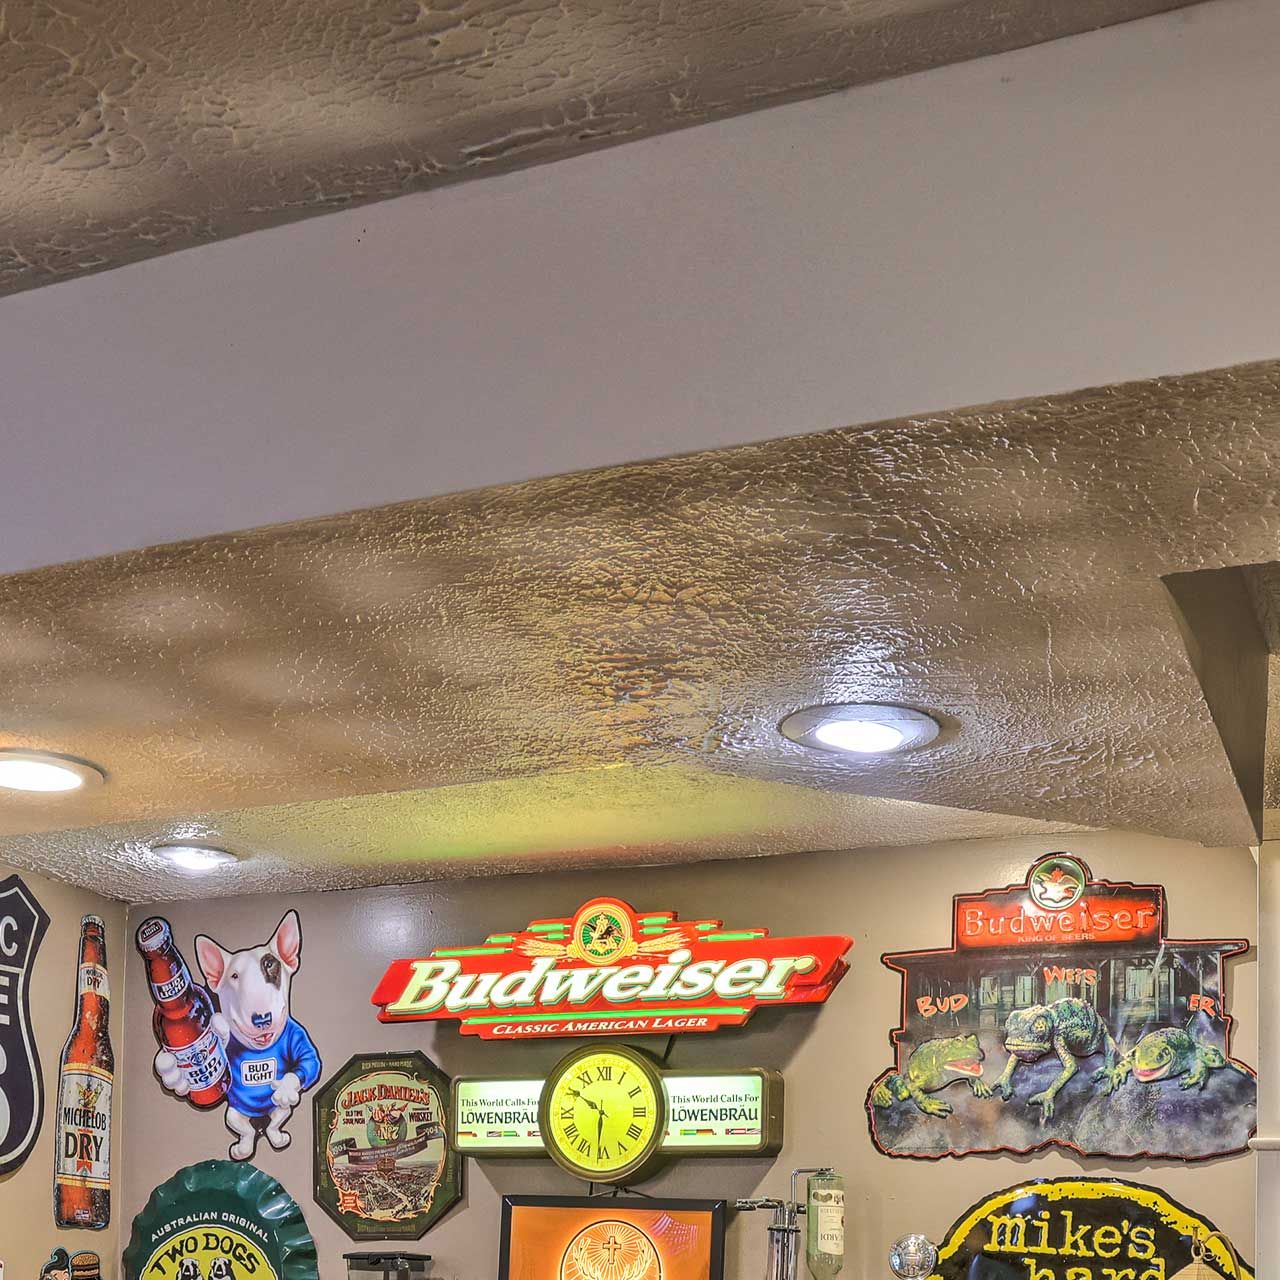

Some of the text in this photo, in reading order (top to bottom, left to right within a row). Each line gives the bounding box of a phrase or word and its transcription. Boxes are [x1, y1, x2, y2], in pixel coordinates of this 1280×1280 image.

[963, 900, 1155, 937] Budweiser
[1018, 934, 1044, 943] KING
[1062, 933, 1097, 942] BEERS
[160, 980, 186, 999] LIGHT
[162, 976, 181, 992] BUD
[389, 950, 819, 1014] Budweiser
[916, 994, 968, 1019] BUD
[1188, 993, 1215, 1017] ER
[492, 1017, 709, 1036] CLASSIC AMERICAN LAGER
[189, 1057, 217, 1078] BUD
[245, 1071, 273, 1082] LIGHT
[248, 1063, 269, 1073] BUD
[597, 1066, 612, 1081] XII
[576, 1070, 593, 1089] XI
[617, 1071, 627, 1085] I
[628, 1085, 642, 1099] II
[671, 1093, 760, 1104] This World Calls For
[461, 1098, 478, 1107] This
[479, 1098, 504, 1107] World
[505, 1098, 526, 1107] Calls
[633, 1107, 646, 1117] III
[63, 1106, 107, 1131] MICHELOB
[561, 1106, 574, 1119] IX
[563, 1122, 580, 1145] VIII
[626, 1122, 643, 1141] IIII
[64, 1131, 104, 1162] DRY
[577, 1139, 591, 1157] VII
[617, 1141, 628, 1155] V
[151, 1212, 269, 1243] AUSTRALIAN ORIGINAL
[984, 1210, 1158, 1259] mike's
[149, 1233, 261, 1275] TWO DOGS
